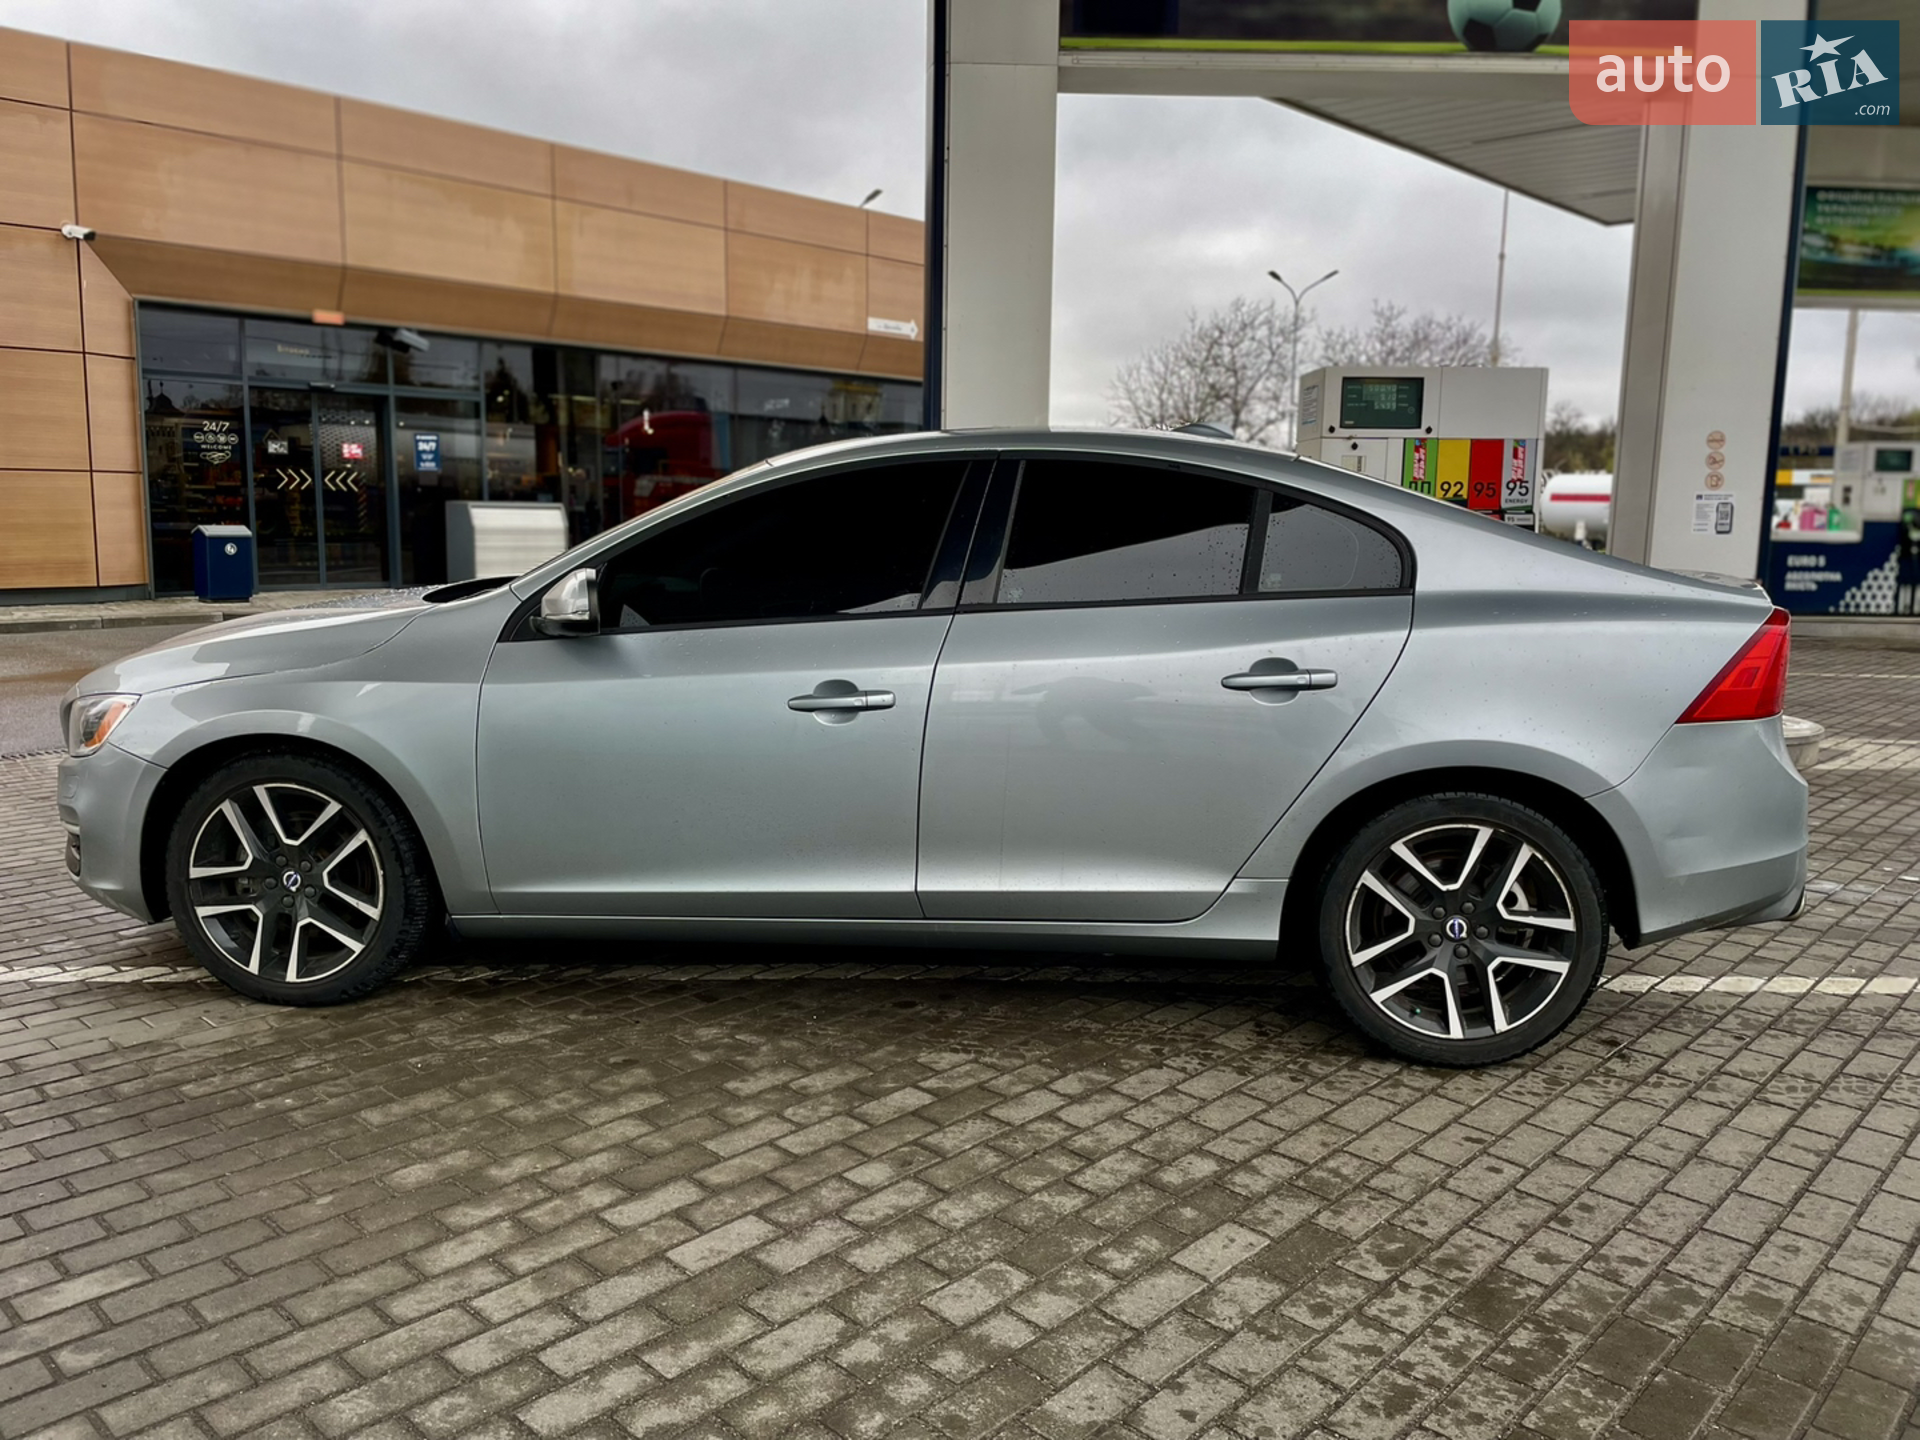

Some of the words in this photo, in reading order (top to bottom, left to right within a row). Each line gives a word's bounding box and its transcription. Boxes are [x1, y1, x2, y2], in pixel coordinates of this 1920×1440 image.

[202, 420, 230, 432] 24/7
[1440, 481, 1464, 498] 92
[1473, 482, 1497, 498] 95
[1505, 480, 1530, 497] 95
